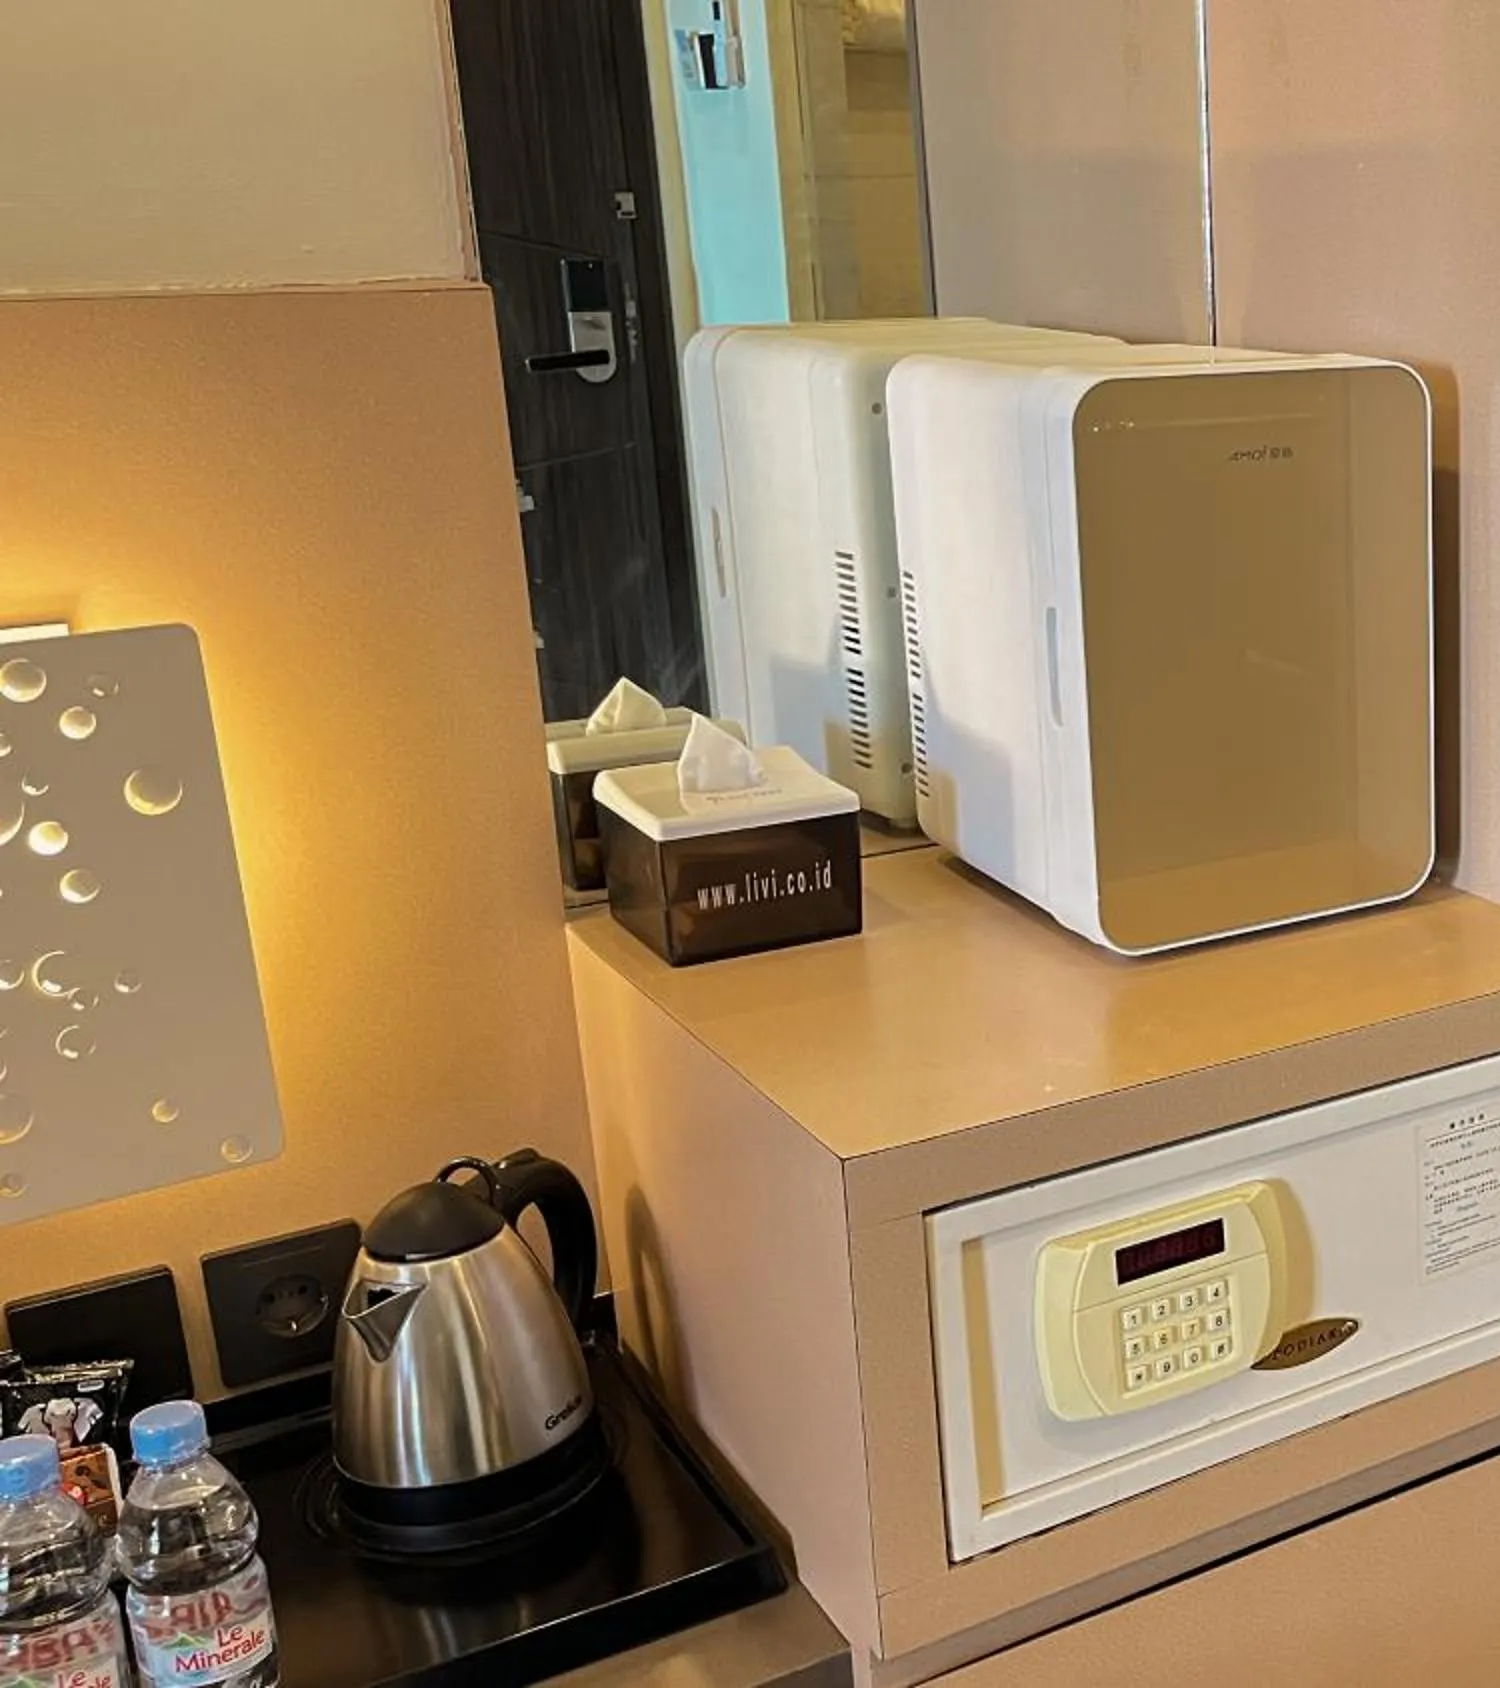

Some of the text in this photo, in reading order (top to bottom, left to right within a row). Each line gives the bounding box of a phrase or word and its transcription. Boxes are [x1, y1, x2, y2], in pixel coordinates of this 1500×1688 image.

[697, 859, 832, 910] www.livi.co.id
[175, 1630, 265, 1673] Minerale
[217, 1624, 243, 1647] Le
